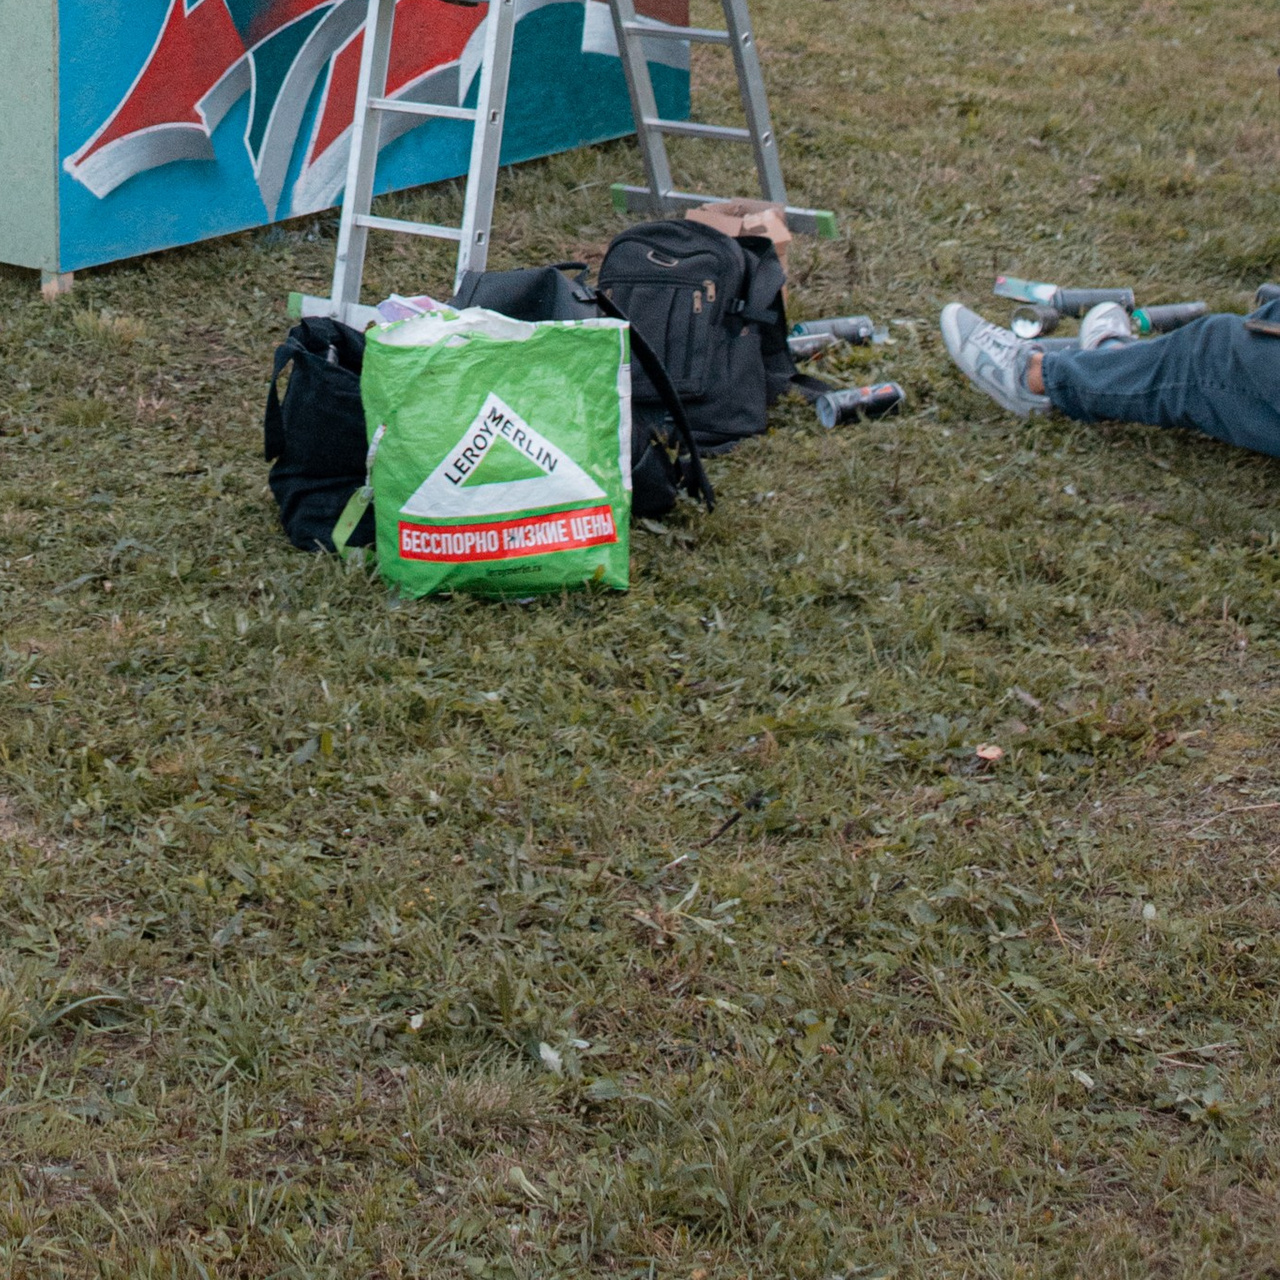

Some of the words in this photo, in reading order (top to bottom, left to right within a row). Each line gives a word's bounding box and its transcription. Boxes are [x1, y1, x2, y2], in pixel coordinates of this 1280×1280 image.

[444, 421, 494, 486] LEROY
[487, 406, 559, 472] MERLIN
[401, 529, 499, 555] БЕССПОРНО
[503, 520, 569, 551] НИЗКИЕ
[571, 512, 614, 543] ЦЕНЫ
